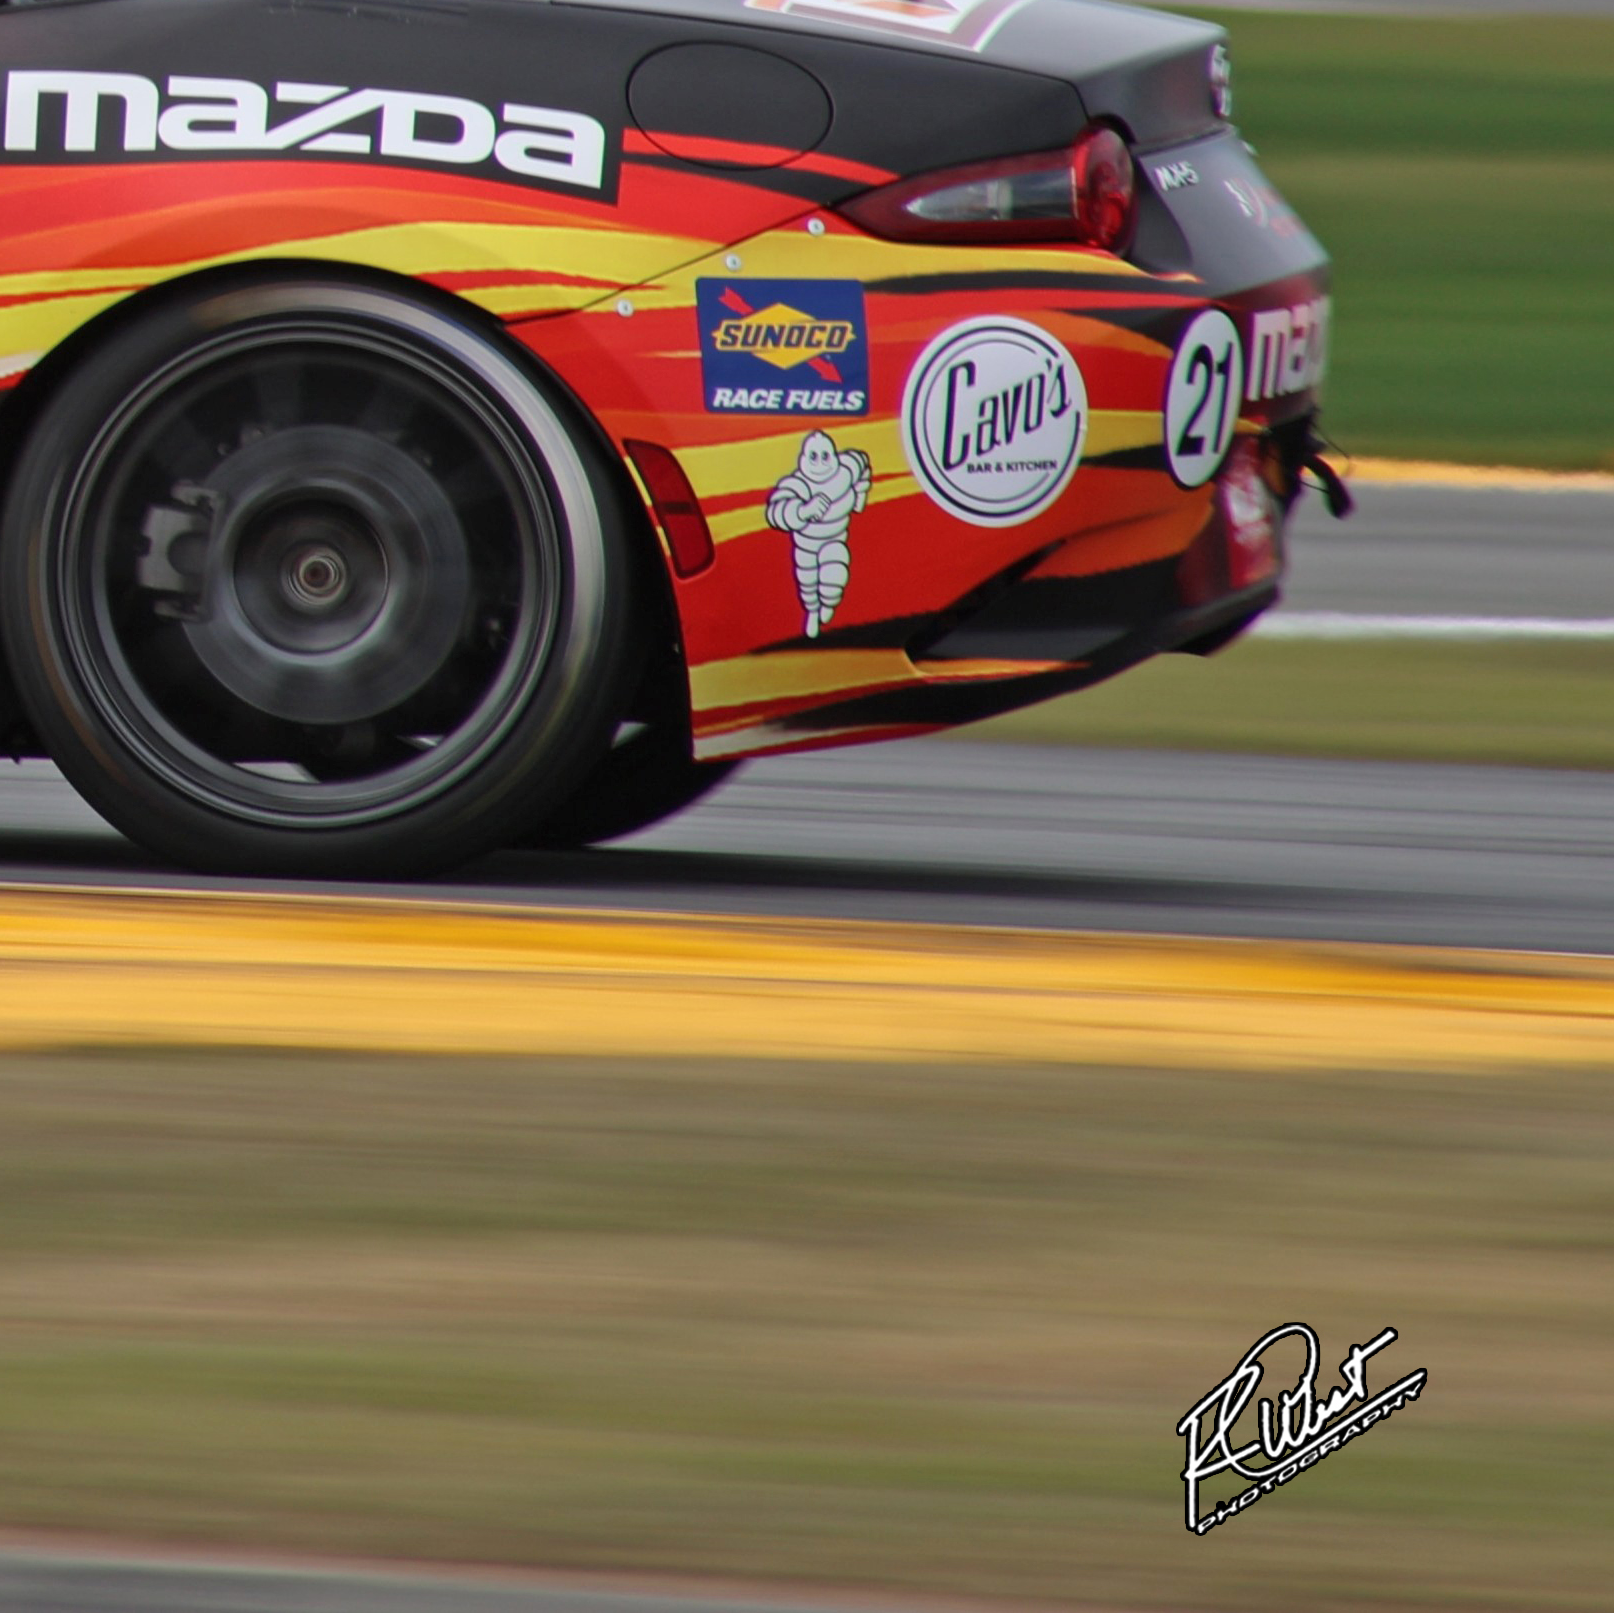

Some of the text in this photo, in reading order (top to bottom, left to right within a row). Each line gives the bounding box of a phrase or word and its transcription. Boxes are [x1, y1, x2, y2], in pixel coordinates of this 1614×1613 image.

[719, 323, 849, 349] SUNOCO
[712, 387, 866, 411] RACE FUELS
[1175, 341, 1235, 457] 21
[942, 357, 1072, 471] Cavo's
[967, 460, 1058, 474] BAR & KITCHEN
